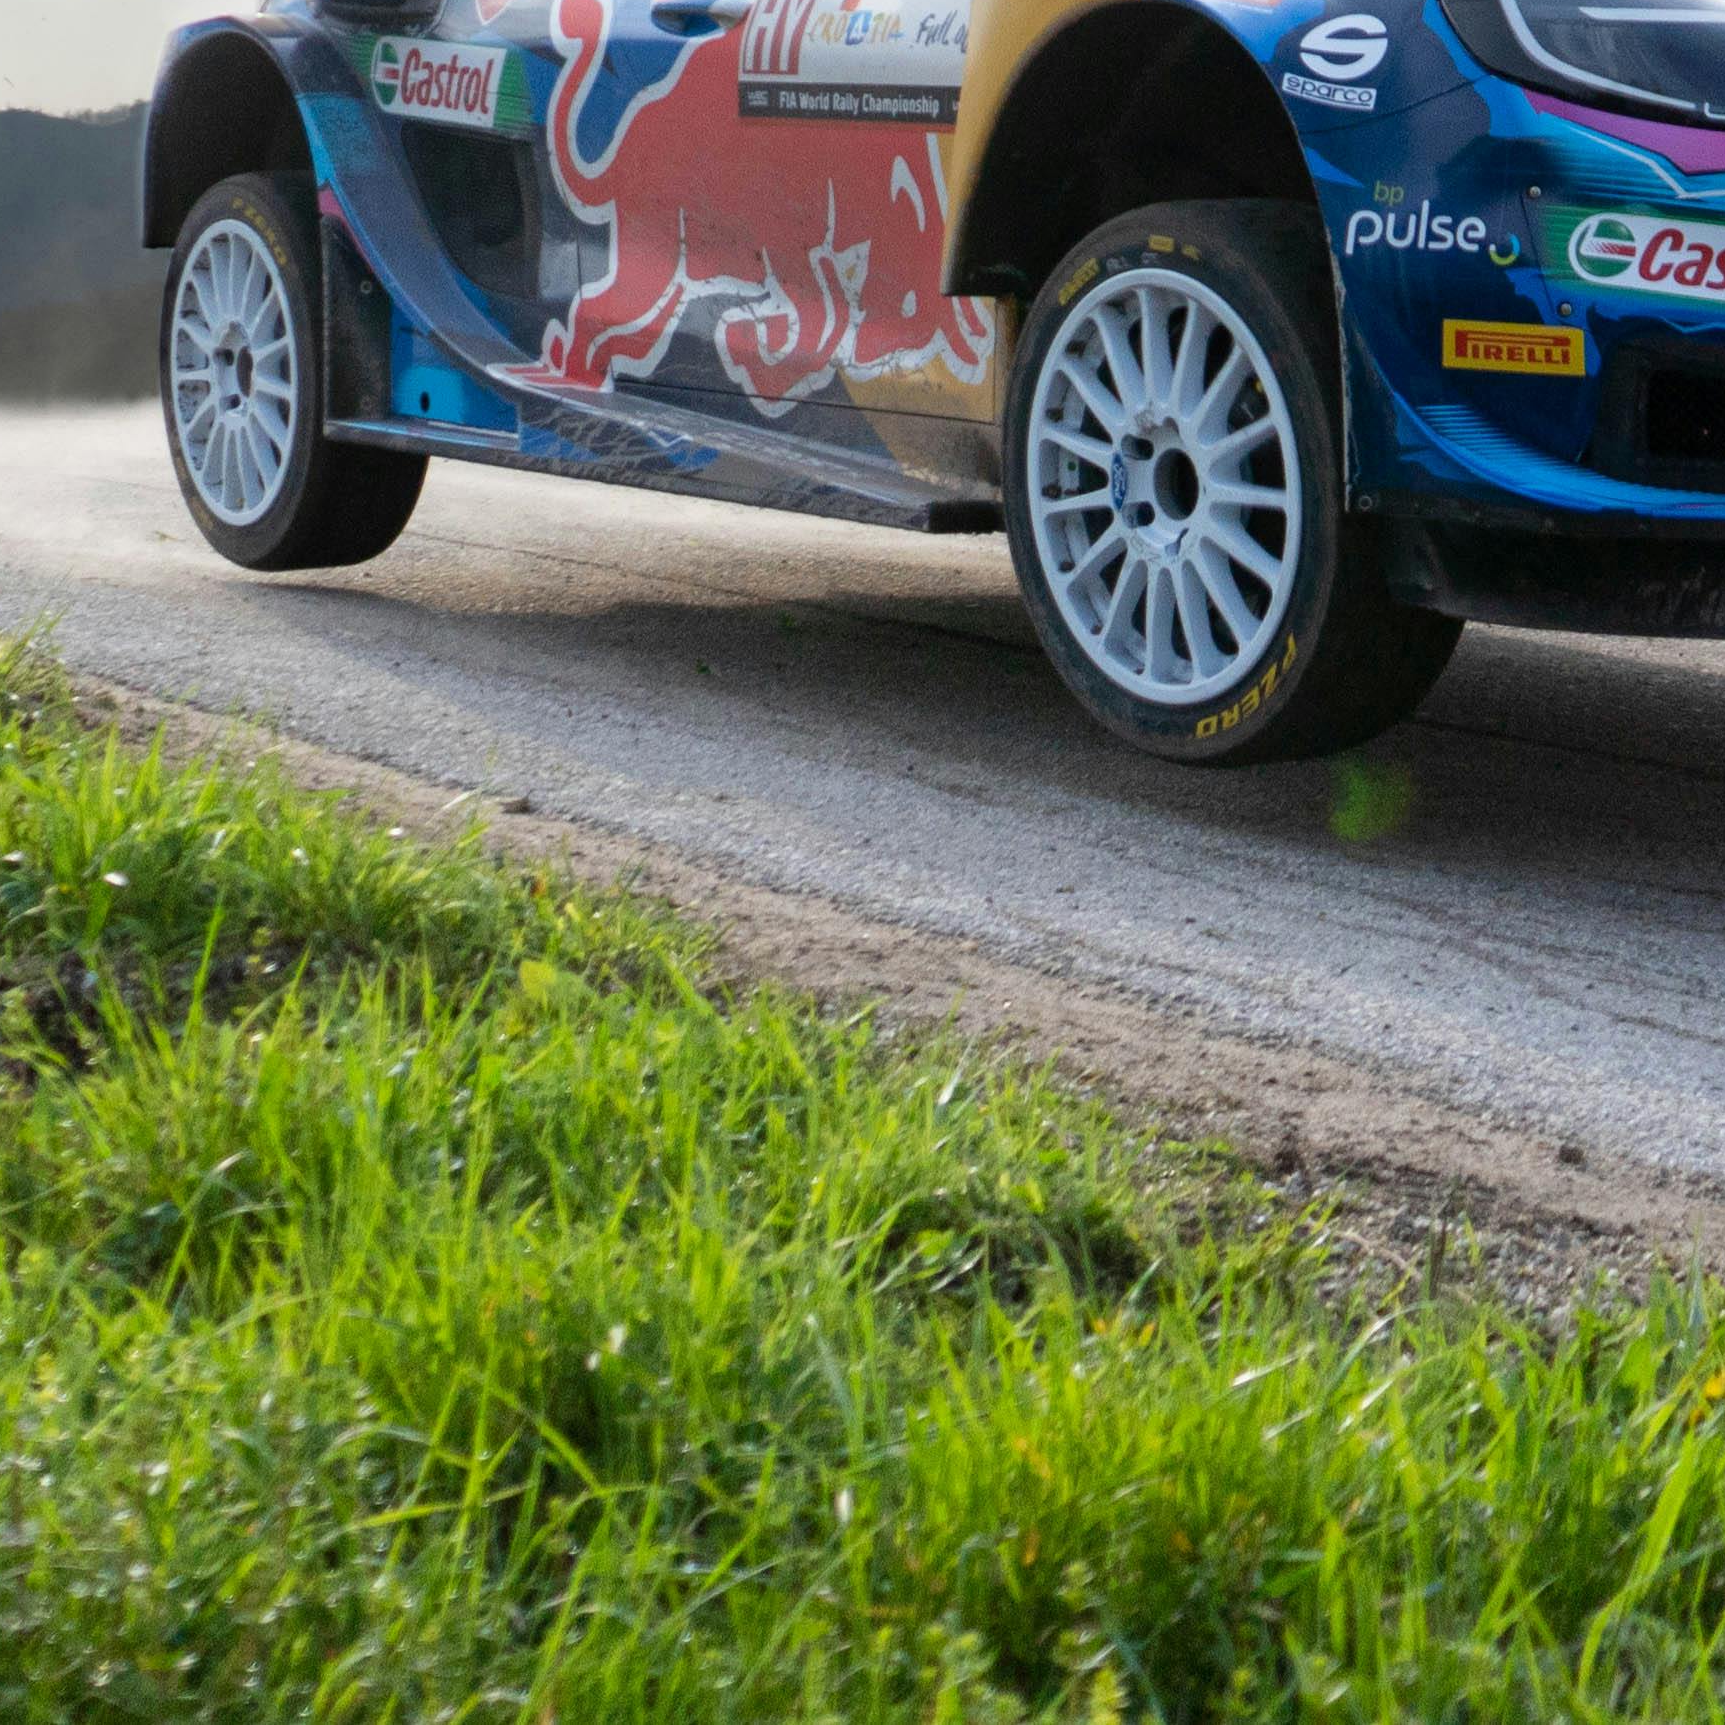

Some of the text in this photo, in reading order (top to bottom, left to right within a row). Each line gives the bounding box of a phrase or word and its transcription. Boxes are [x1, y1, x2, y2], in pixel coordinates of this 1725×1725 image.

[916, 10, 958, 48] Full
[401, 47, 494, 114] Castrol
[1285, 75, 1374, 104] sparco
[779, 91, 797, 109] FIA
[799, 92, 830, 110] World
[832, 93, 860, 116] Rally
[862, 94, 940, 118] Championship
[1374, 181, 1405, 206] bp
[1345, 199, 1486, 255] pulse
[1455, 329, 1570, 365] PIRELLI
[1195, 662, 1278, 739] ZERO
